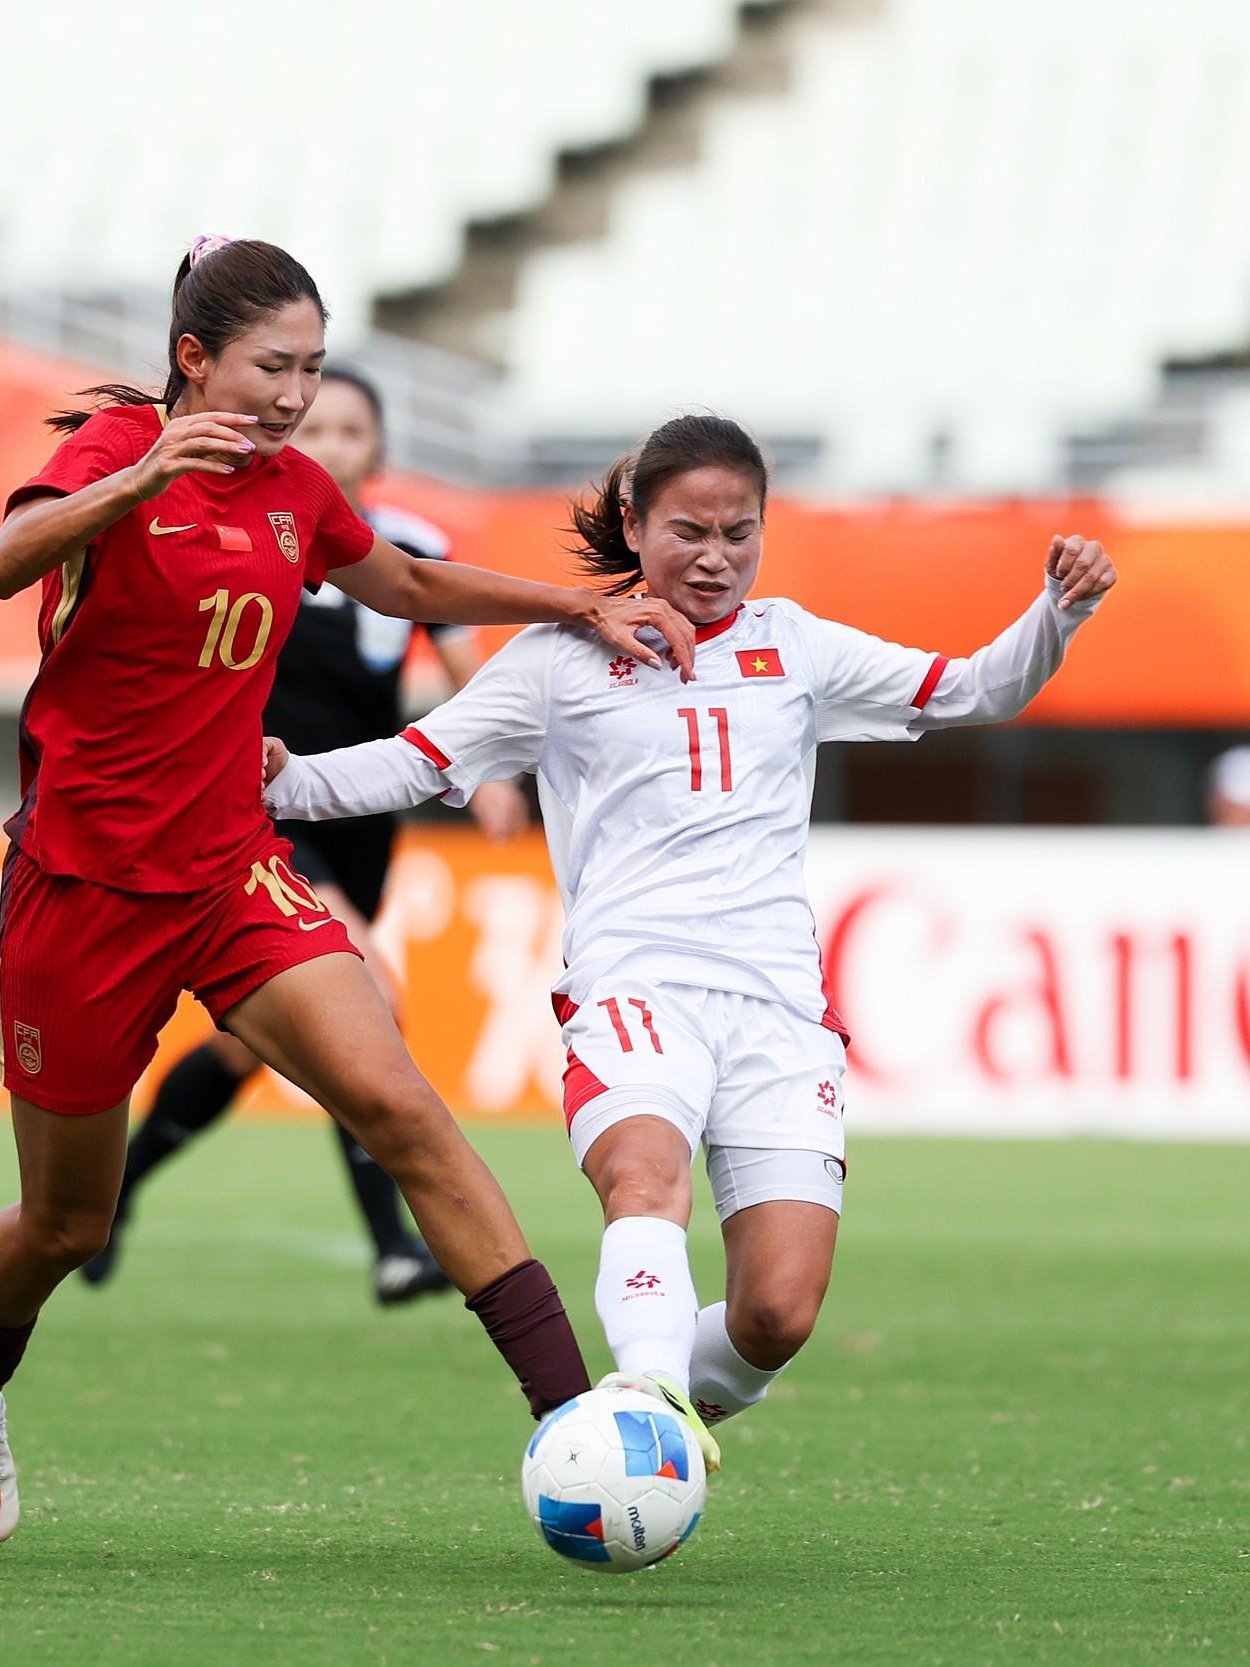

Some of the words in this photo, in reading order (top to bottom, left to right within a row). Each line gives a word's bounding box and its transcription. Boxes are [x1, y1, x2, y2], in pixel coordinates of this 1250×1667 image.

[198, 588, 273, 670] 10
[677, 708, 732, 792] 11
[244, 855, 326, 917] 10
[596, 997, 664, 1054] 11
[627, 1506, 647, 1551] molten
